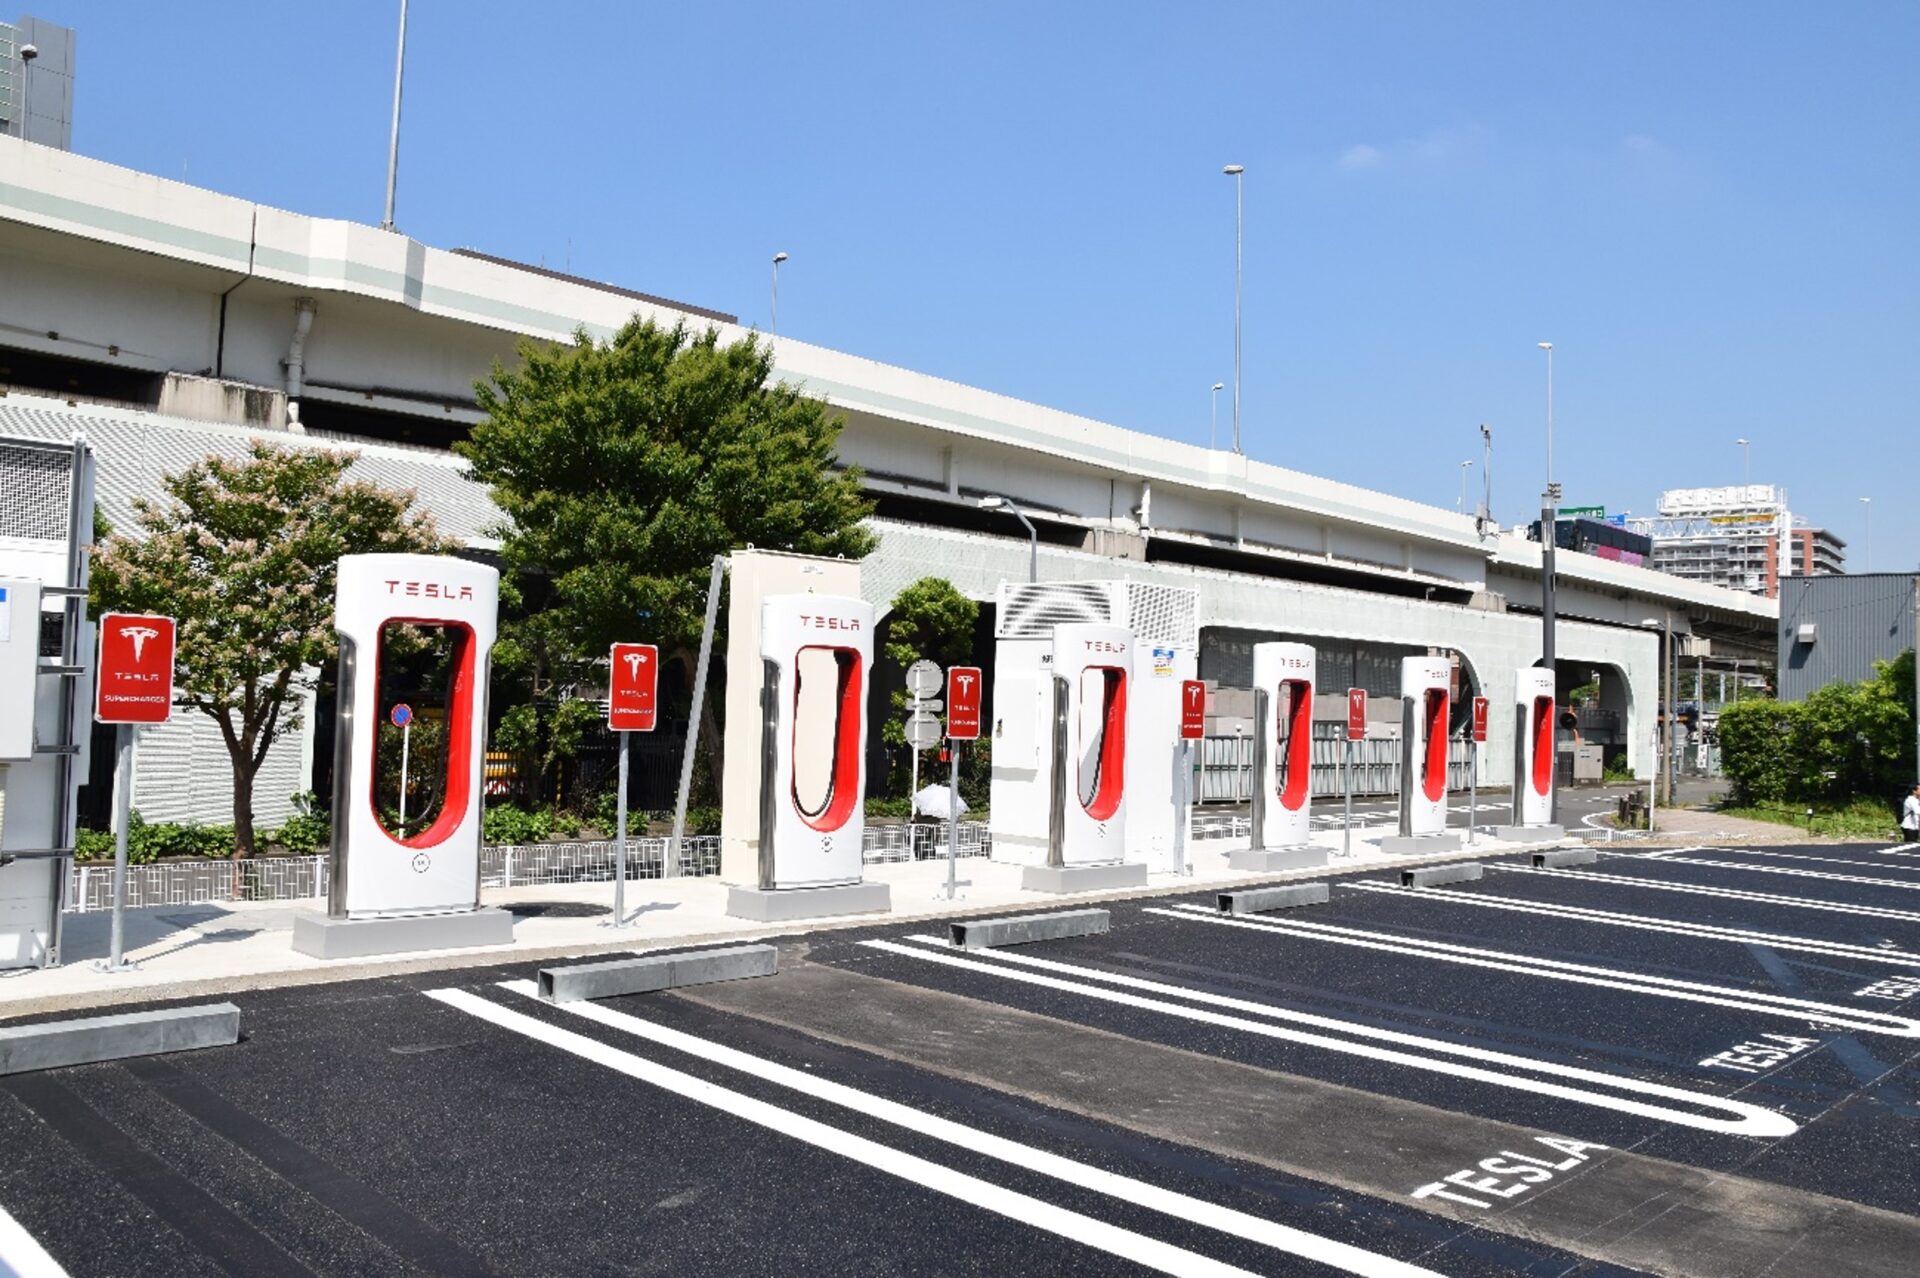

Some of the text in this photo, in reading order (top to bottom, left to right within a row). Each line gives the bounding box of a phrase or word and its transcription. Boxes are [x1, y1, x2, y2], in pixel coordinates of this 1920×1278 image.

[384, 580, 473, 601] TESLA
[799, 614, 860, 631] TESLA
[1085, 640, 1126, 653] TESLA
[114, 672, 159, 682] TESLA
[1697, 1033, 1821, 1074] TESLA
[1410, 1136, 1610, 1209] TESLA
